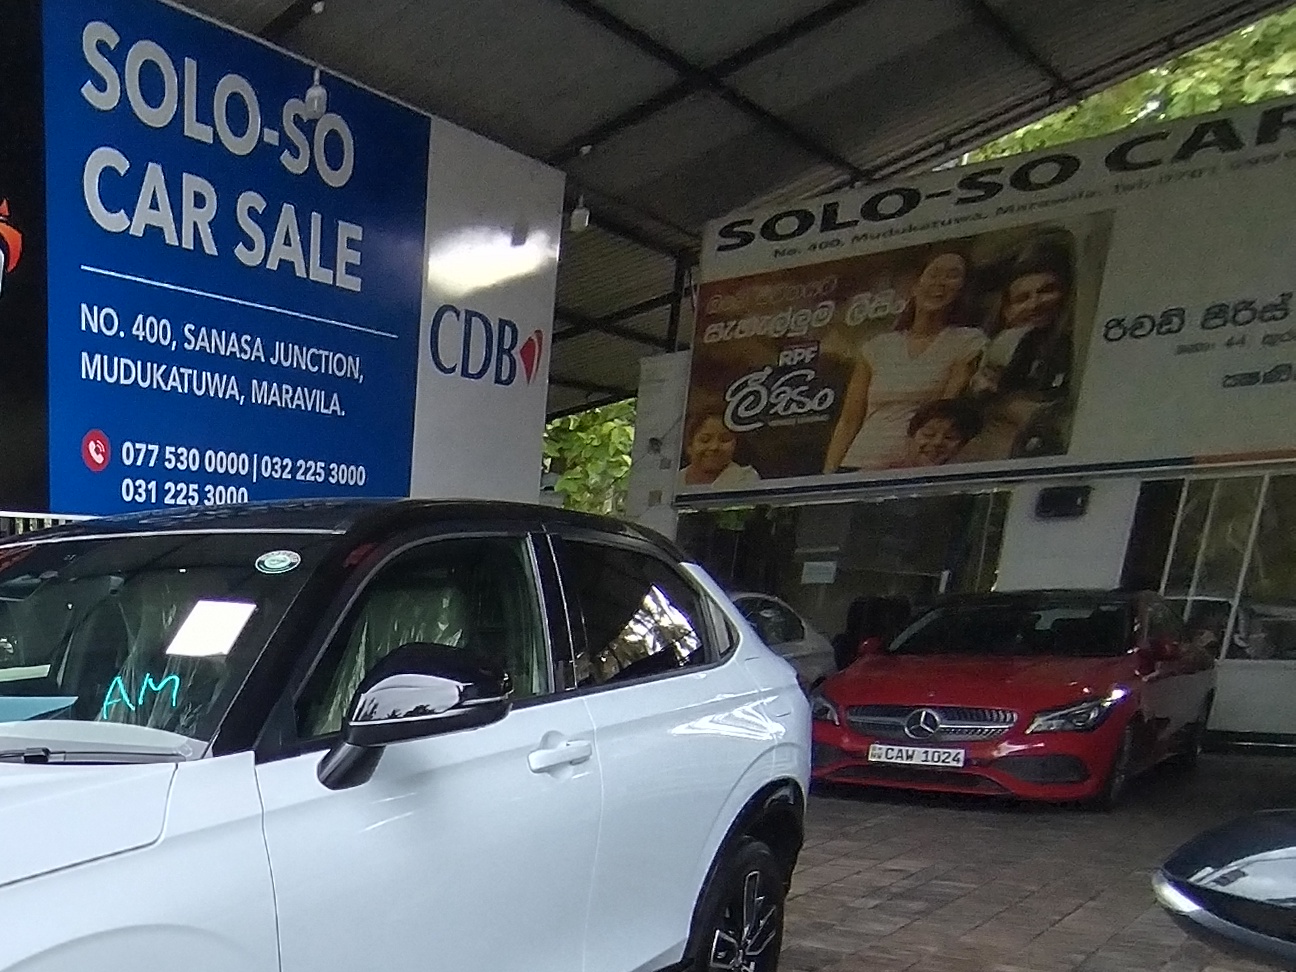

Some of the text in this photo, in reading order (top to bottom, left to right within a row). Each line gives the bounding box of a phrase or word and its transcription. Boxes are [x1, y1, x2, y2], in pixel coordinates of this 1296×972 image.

[81, 21, 354, 187] SOLO-SO
[83, 146, 363, 292] CAR SALE
[716, 153, 1081, 252] SOLO-SO
[80, 303, 364, 383] NO. 400, SANASA JUNCTION,
[430, 304, 518, 386] CDB
[779, 346, 819, 366] RPF
[81, 352, 345, 416] MUDUKATUWA, MARAVILA.
[121, 441, 159, 467] 077
[164, 445, 200, 471] 530
[296, 459, 325, 482] 225
[328, 463, 365, 486] 3000
[121, 478, 249, 506] 031 225 3000
[103, 672, 180, 719] AM
[884, 747, 961, 765] CAW 1024
